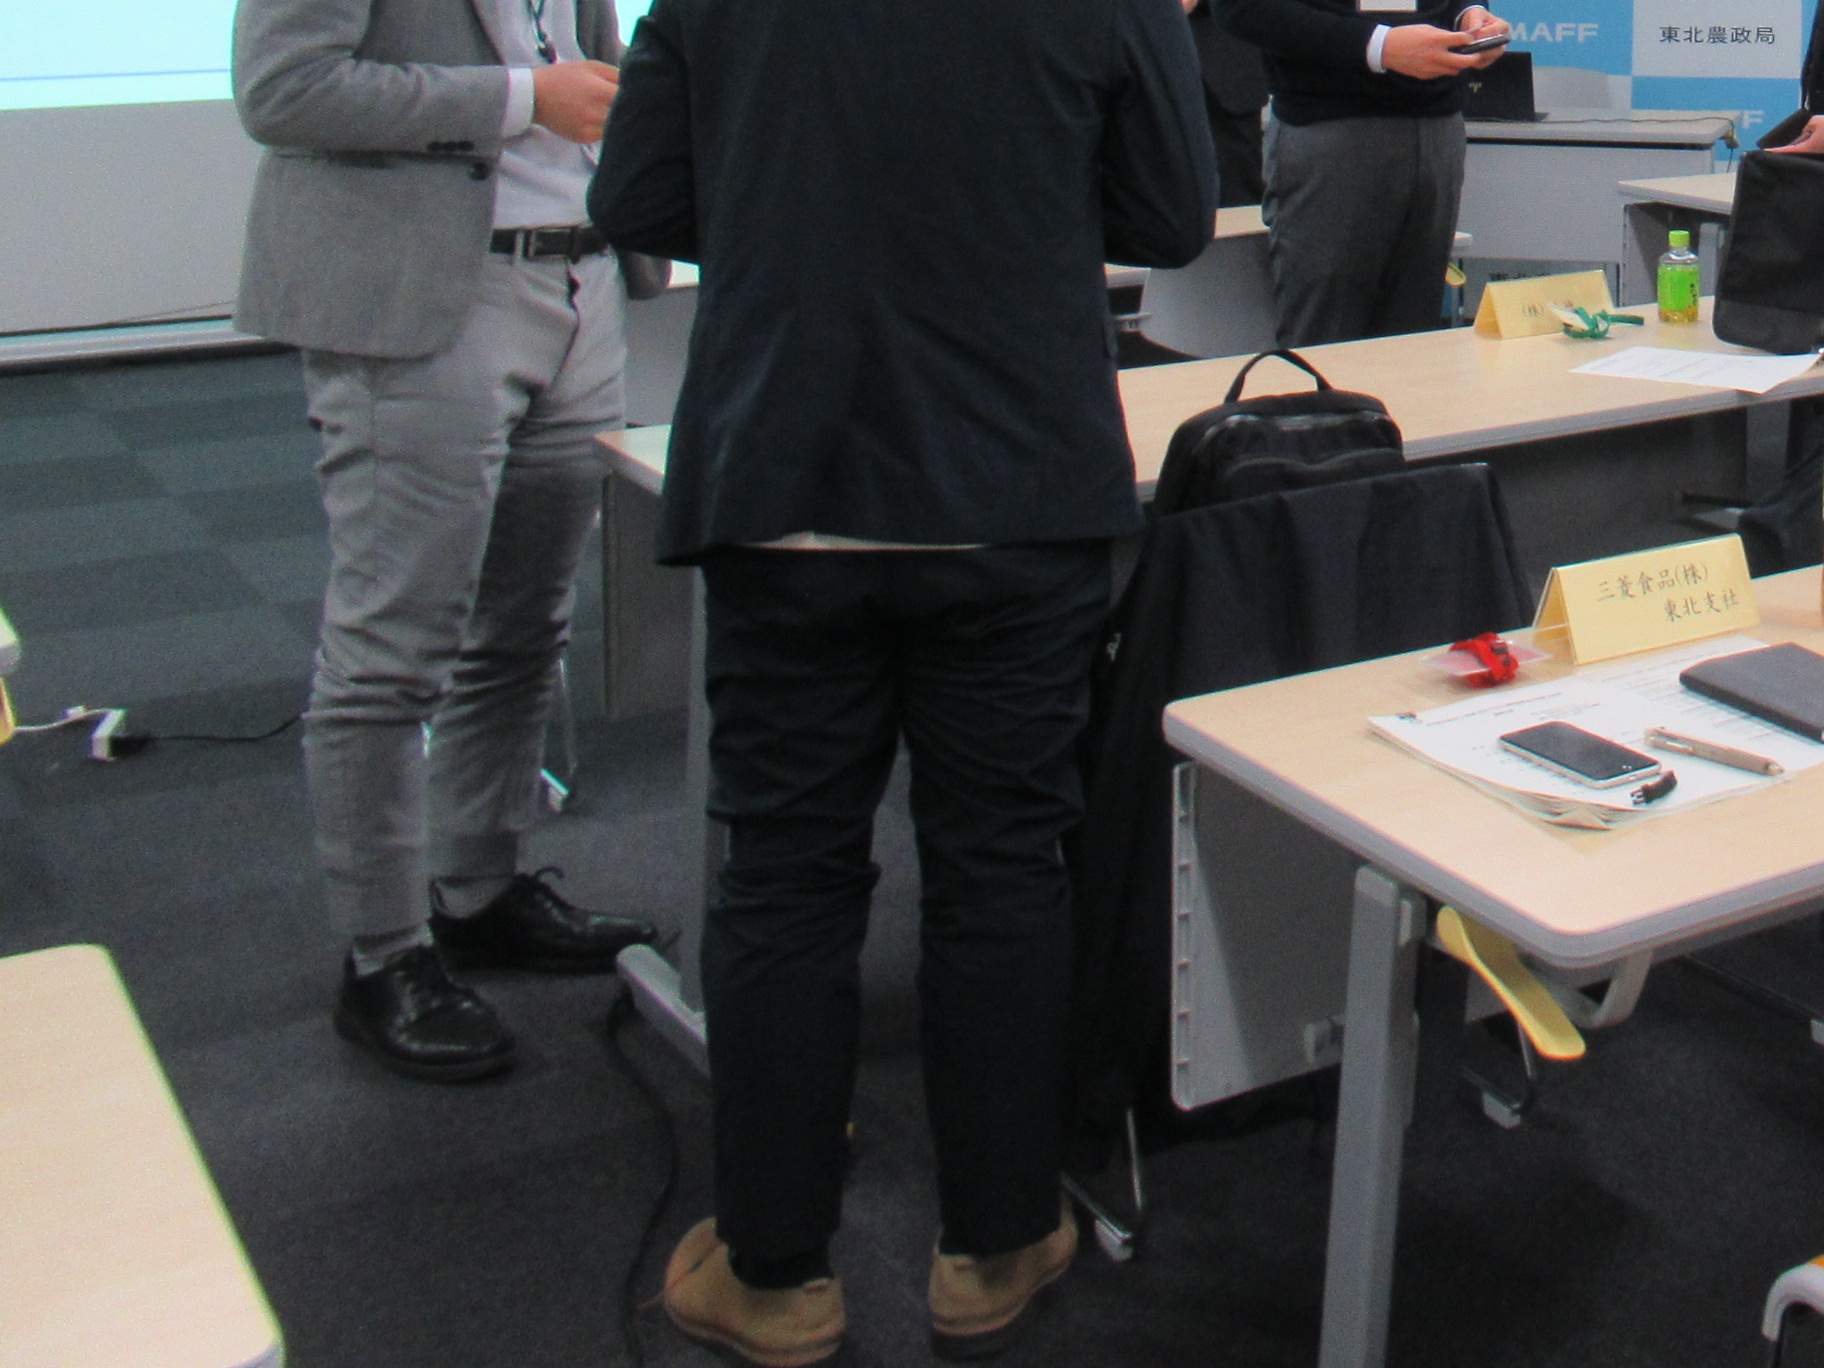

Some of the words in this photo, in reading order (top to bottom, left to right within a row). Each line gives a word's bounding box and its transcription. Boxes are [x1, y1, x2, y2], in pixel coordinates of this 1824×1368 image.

[1658, 25, 1776, 45] 東北農政局
[1664, 588, 1740, 622] 東北支社
